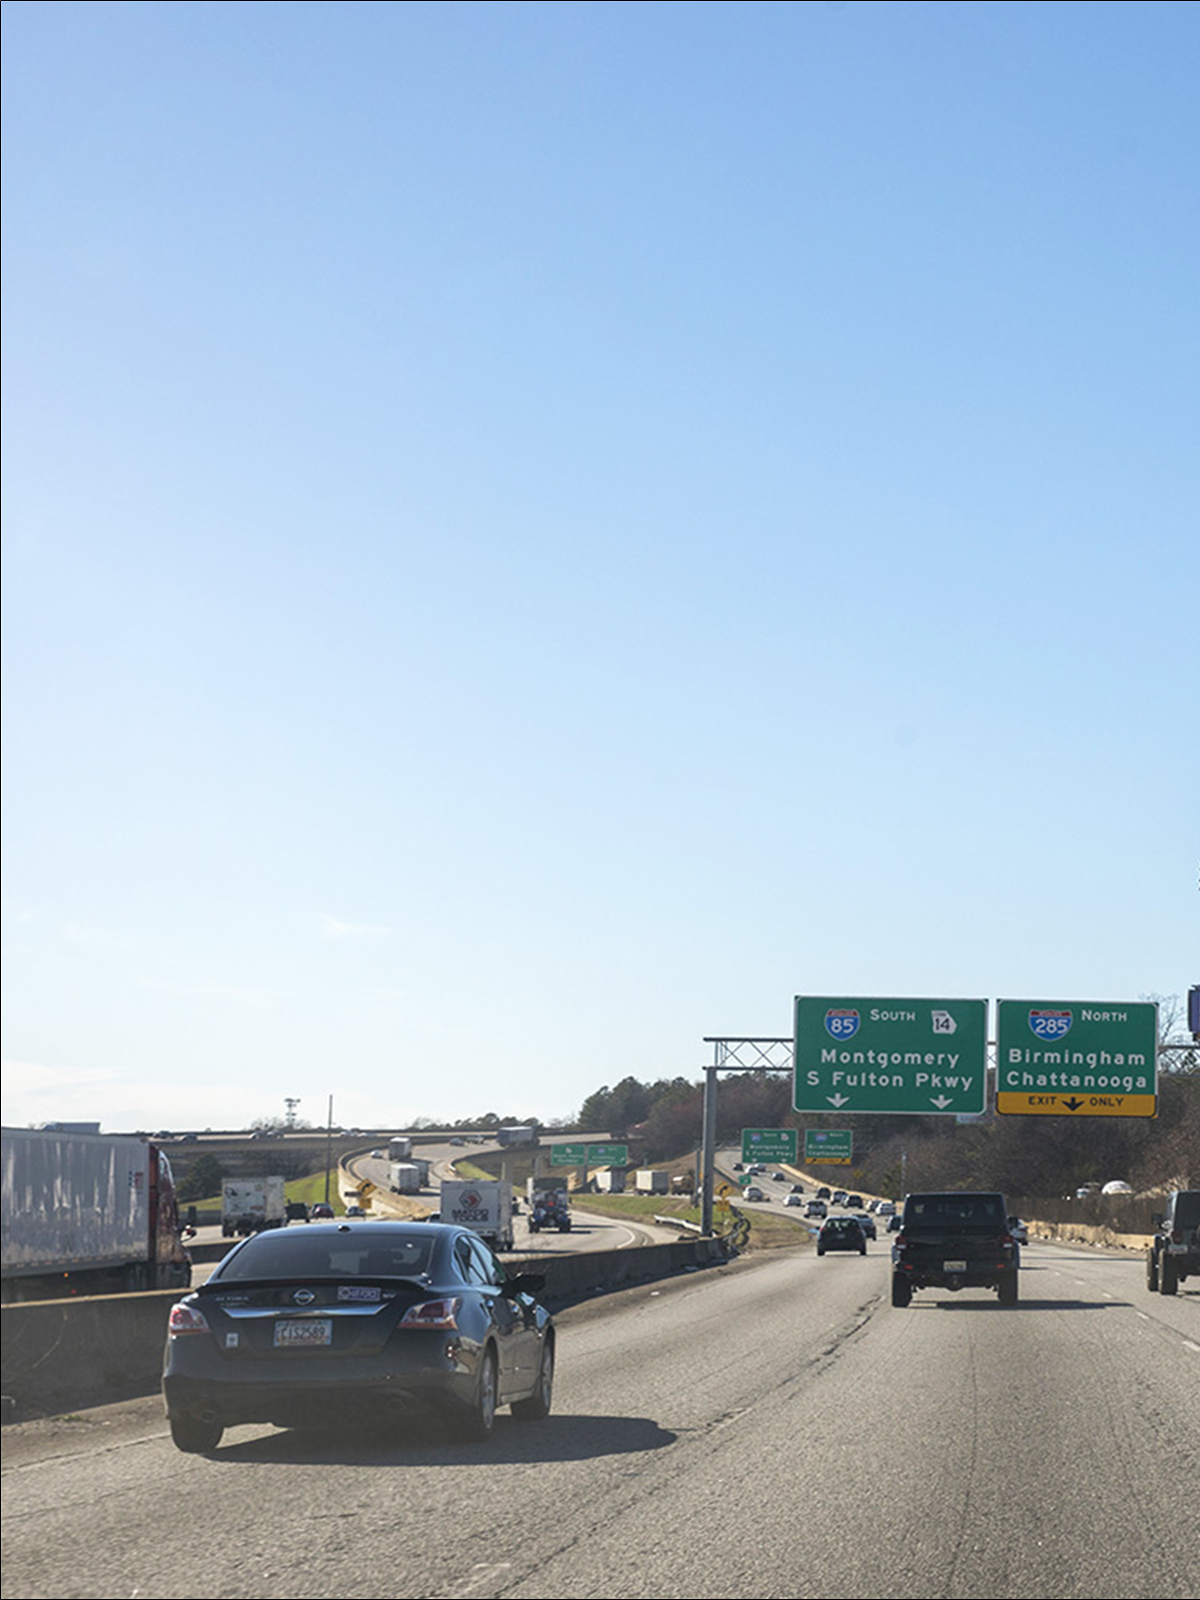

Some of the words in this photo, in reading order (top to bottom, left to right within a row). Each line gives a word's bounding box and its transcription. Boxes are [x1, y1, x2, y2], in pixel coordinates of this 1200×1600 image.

[831, 1018, 855, 1033] 85
[935, 1018, 950, 1031] 14
[1035, 1018, 1069, 1034] 285
[821, 1049, 960, 1068] Montgomery
[1009, 1049, 1146, 1070] Birmingham
[807, 1071, 820, 1086] S
[832, 1071, 904, 1087] Fulton
[915, 1072, 974, 1091] Pkwy
[1006, 1071, 1147, 1091] Chattanooga
[1028, 1096, 1057, 1106] EXIT
[1089, 1096, 1125, 1107] ONLY
